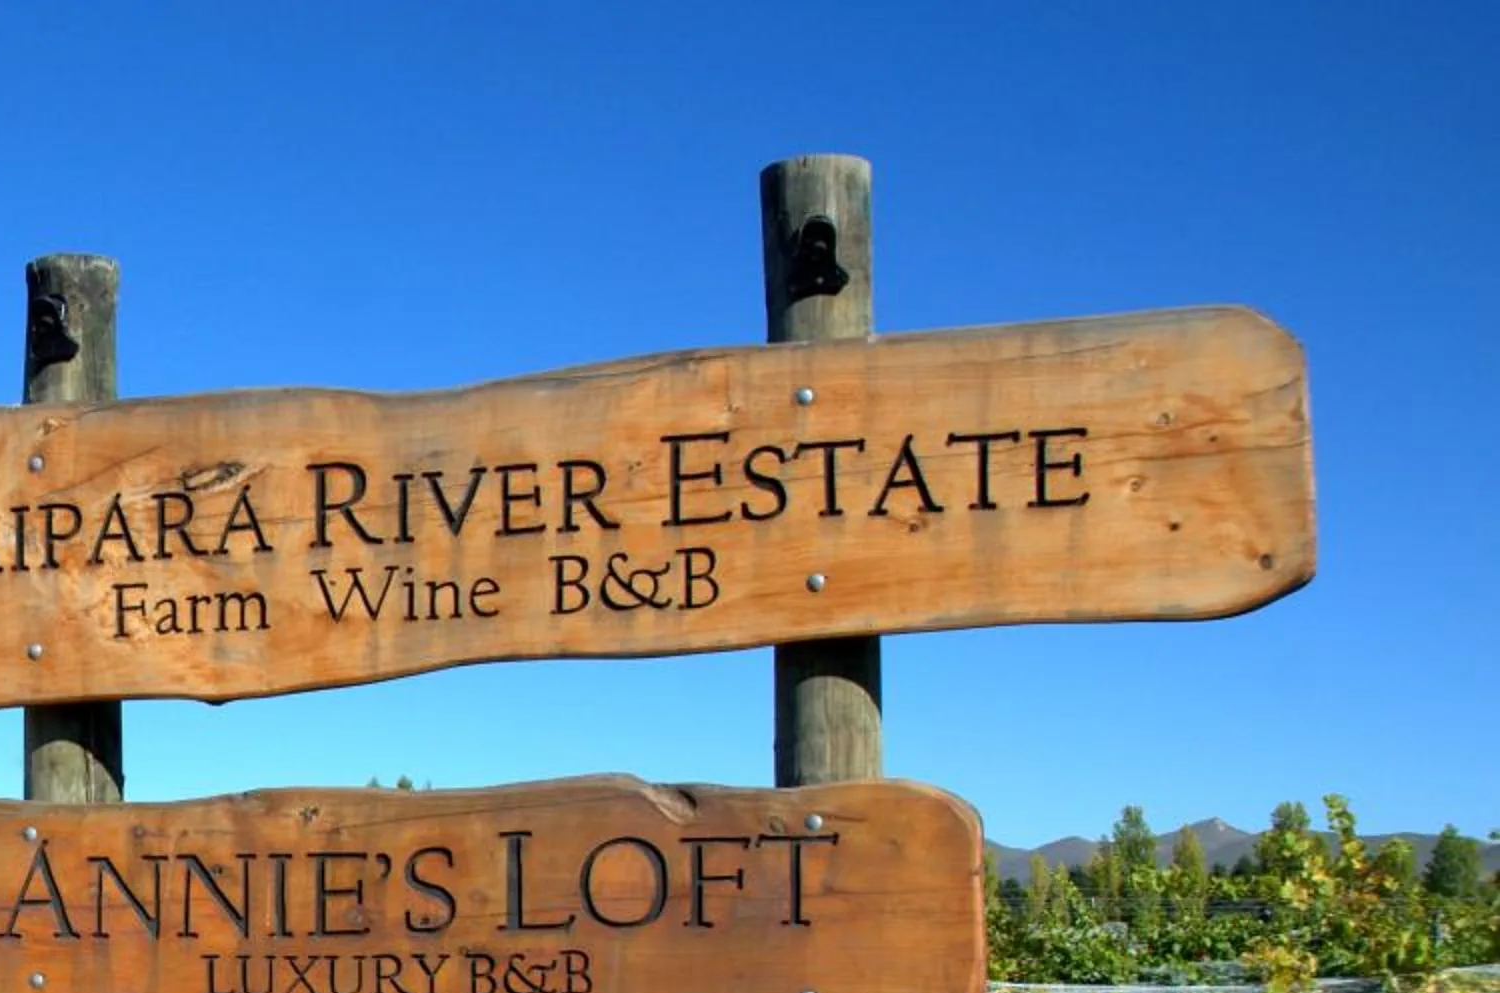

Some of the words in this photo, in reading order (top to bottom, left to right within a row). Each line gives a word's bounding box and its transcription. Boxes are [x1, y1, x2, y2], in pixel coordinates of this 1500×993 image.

[305, 459, 622, 549] RIVER
[660, 427, 1092, 528] ESTATE
[111, 582, 271, 638] Farm
[309, 565, 501, 624] Wine
[548, 546, 722, 614] B&B
[496, 831, 840, 933] LOFT
